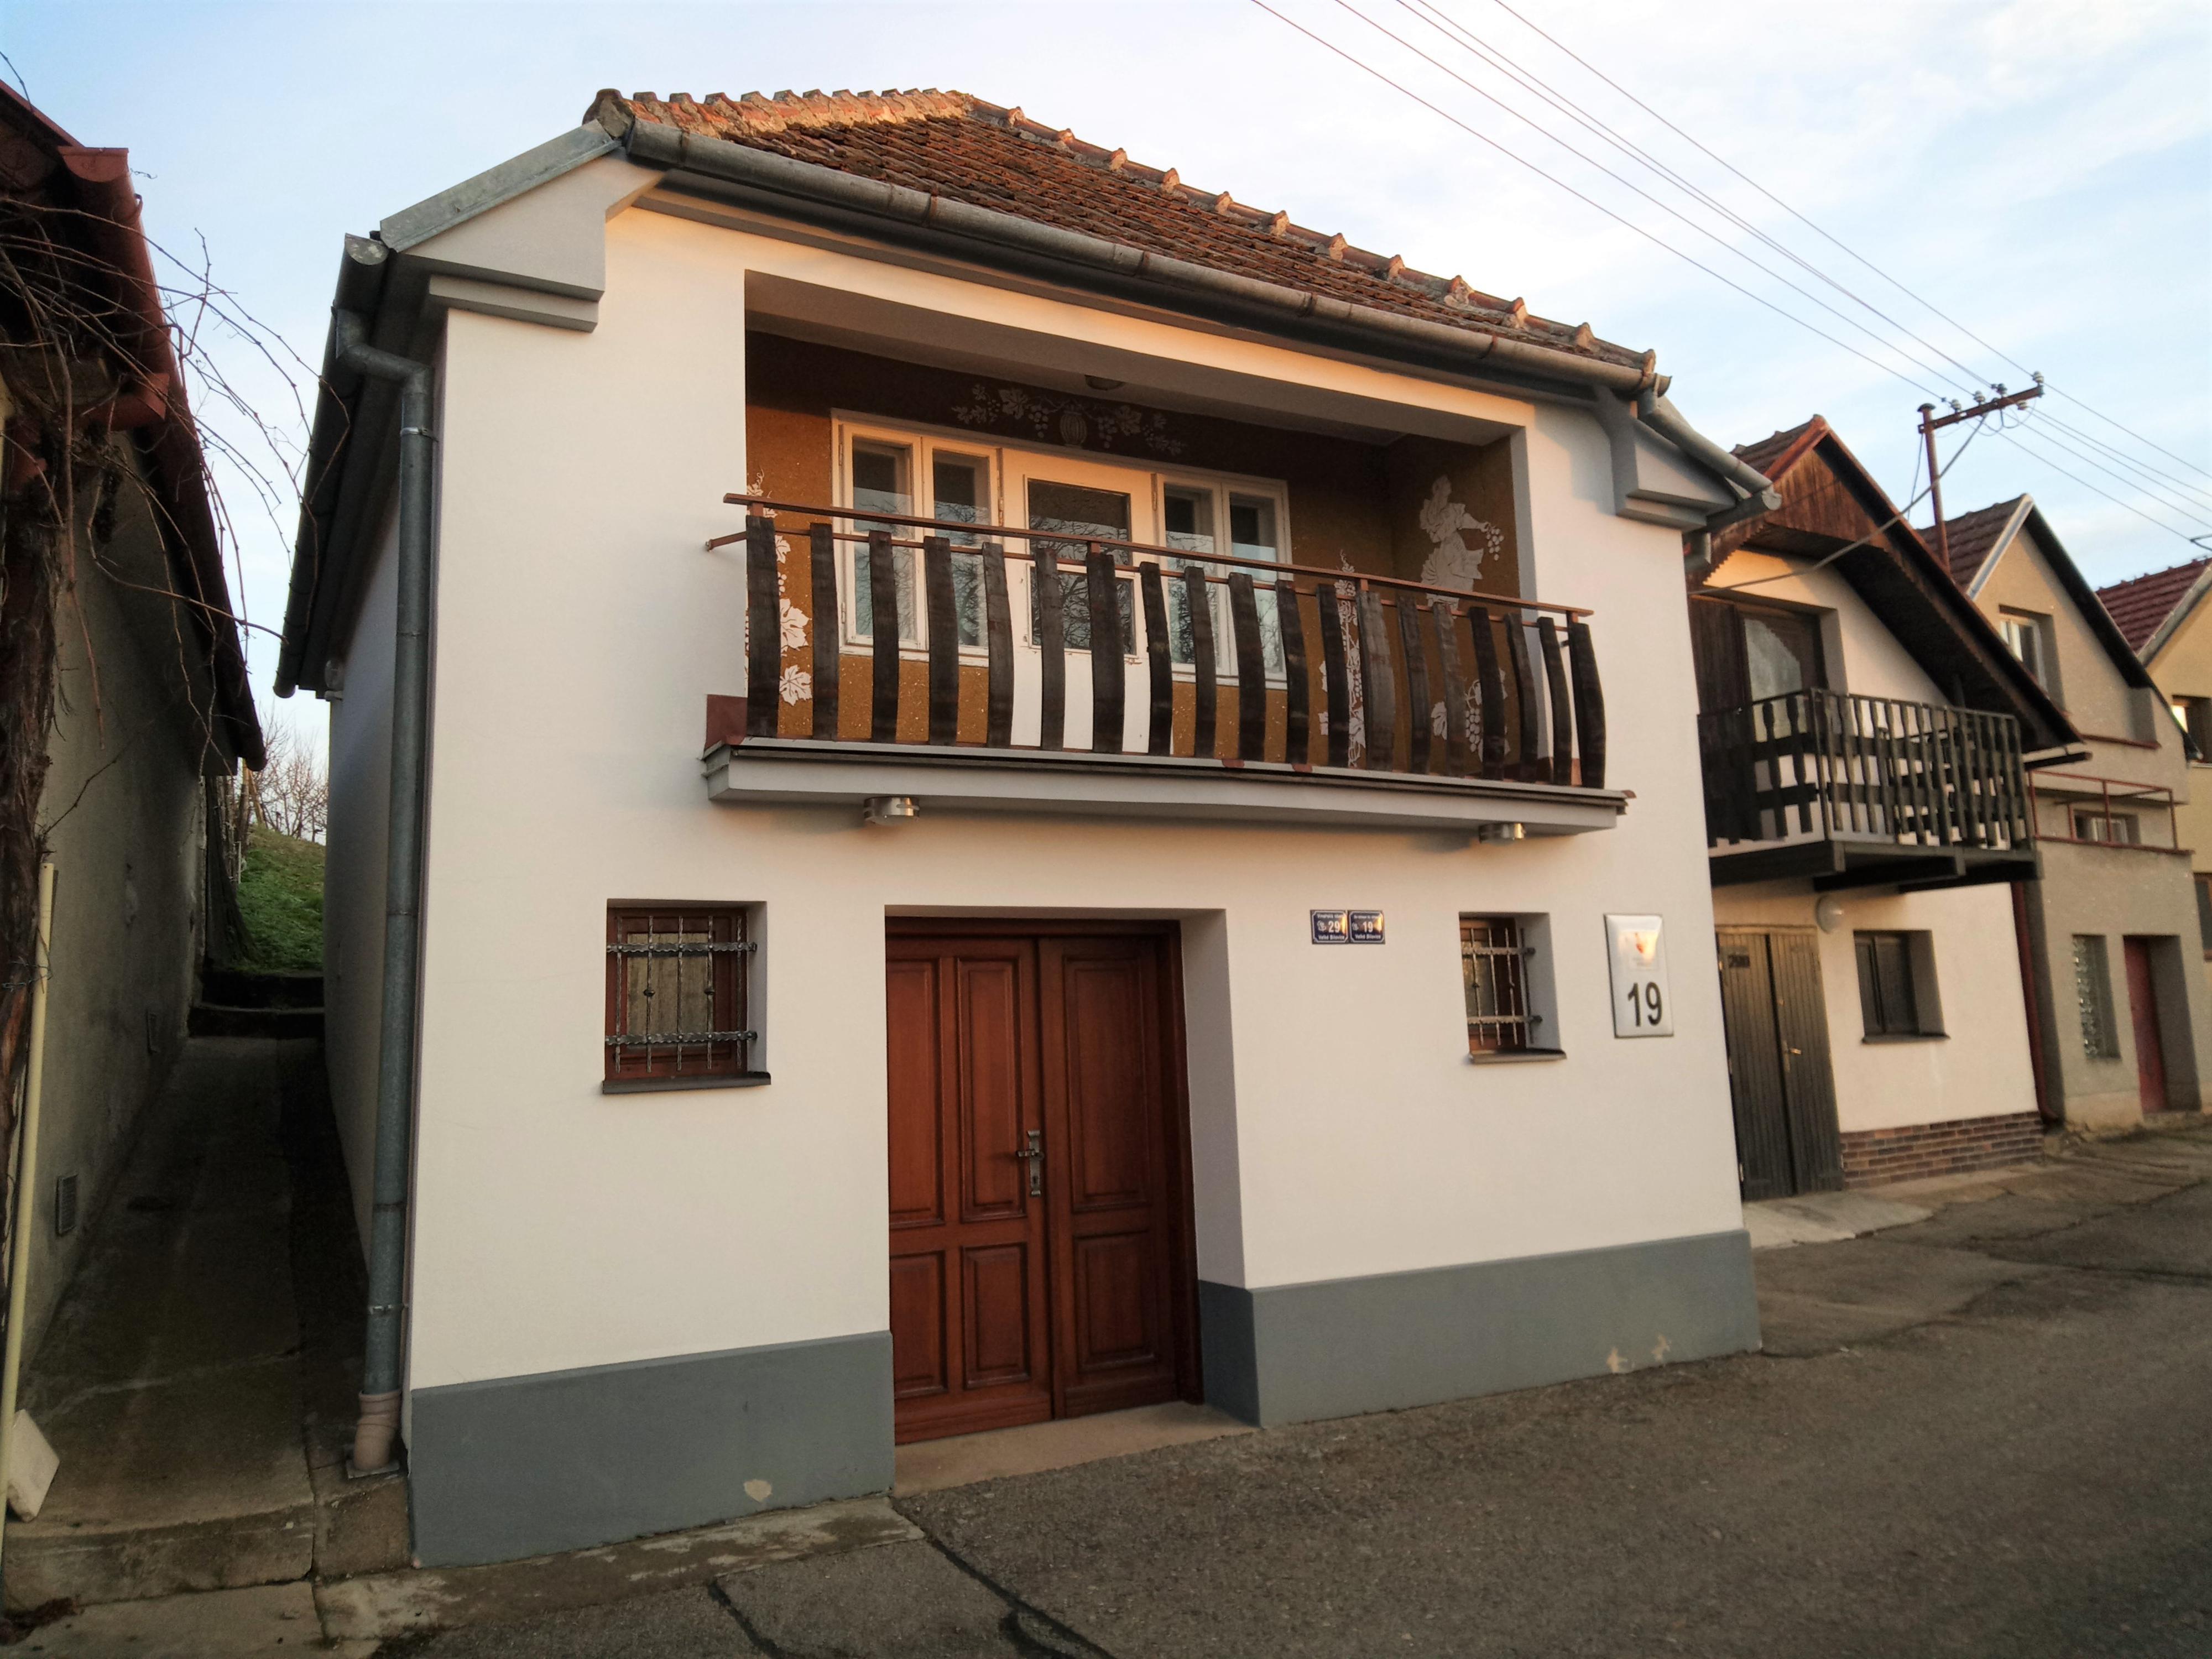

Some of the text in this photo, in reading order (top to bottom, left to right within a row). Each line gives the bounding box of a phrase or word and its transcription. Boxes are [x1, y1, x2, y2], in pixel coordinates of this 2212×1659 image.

[1328, 920, 1340, 933] 29
[1362, 921, 1373, 933] 19
[1627, 982, 1662, 1027] 19
